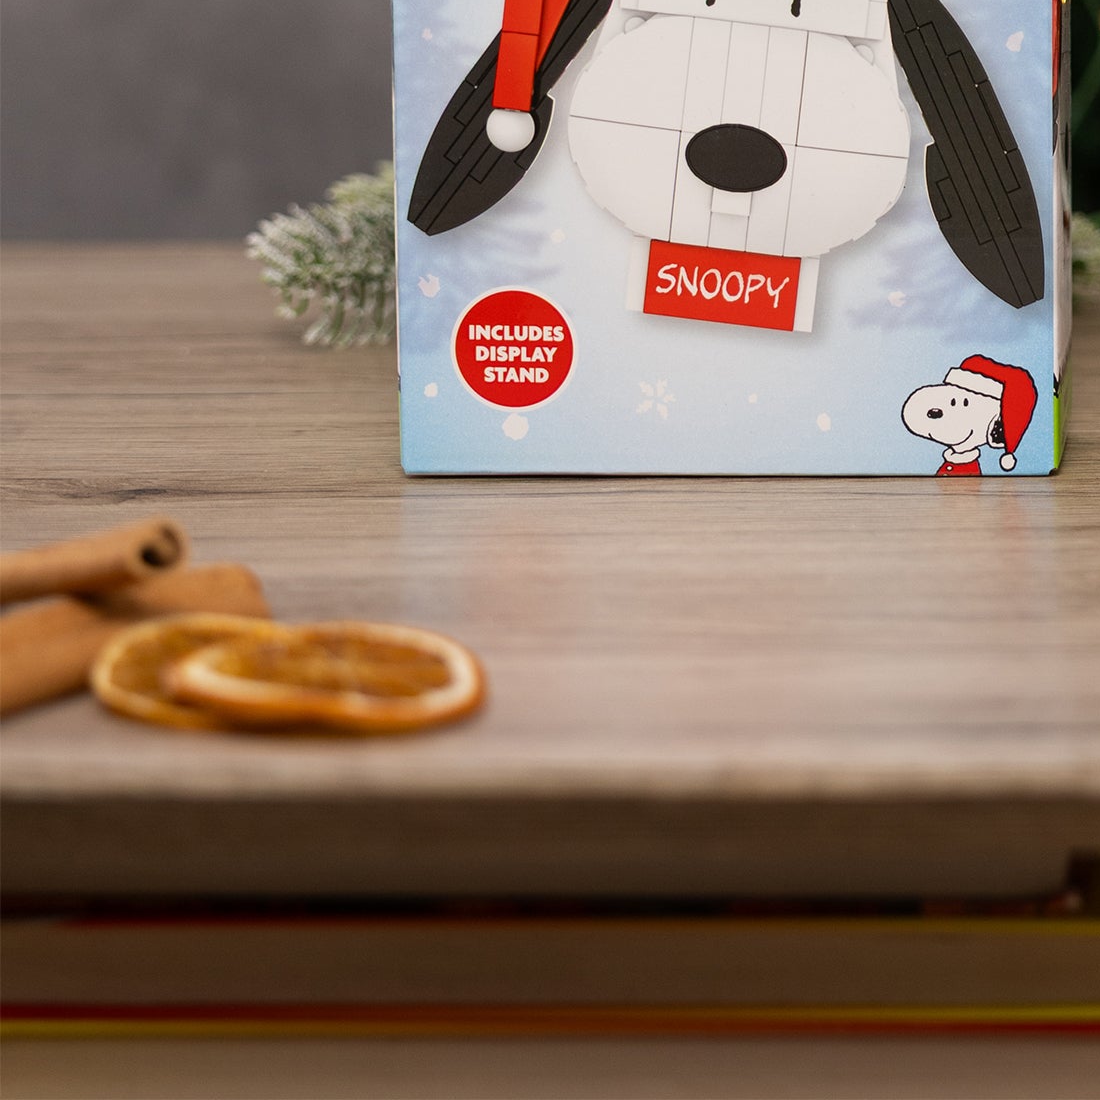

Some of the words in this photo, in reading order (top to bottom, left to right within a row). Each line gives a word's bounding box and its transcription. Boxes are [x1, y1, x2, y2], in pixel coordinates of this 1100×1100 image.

[655, 262, 790, 308] SNOOPY
[468, 324, 565, 343] INCLUDES
[475, 346, 558, 364] DISPLAY
[483, 366, 550, 384] STAND
